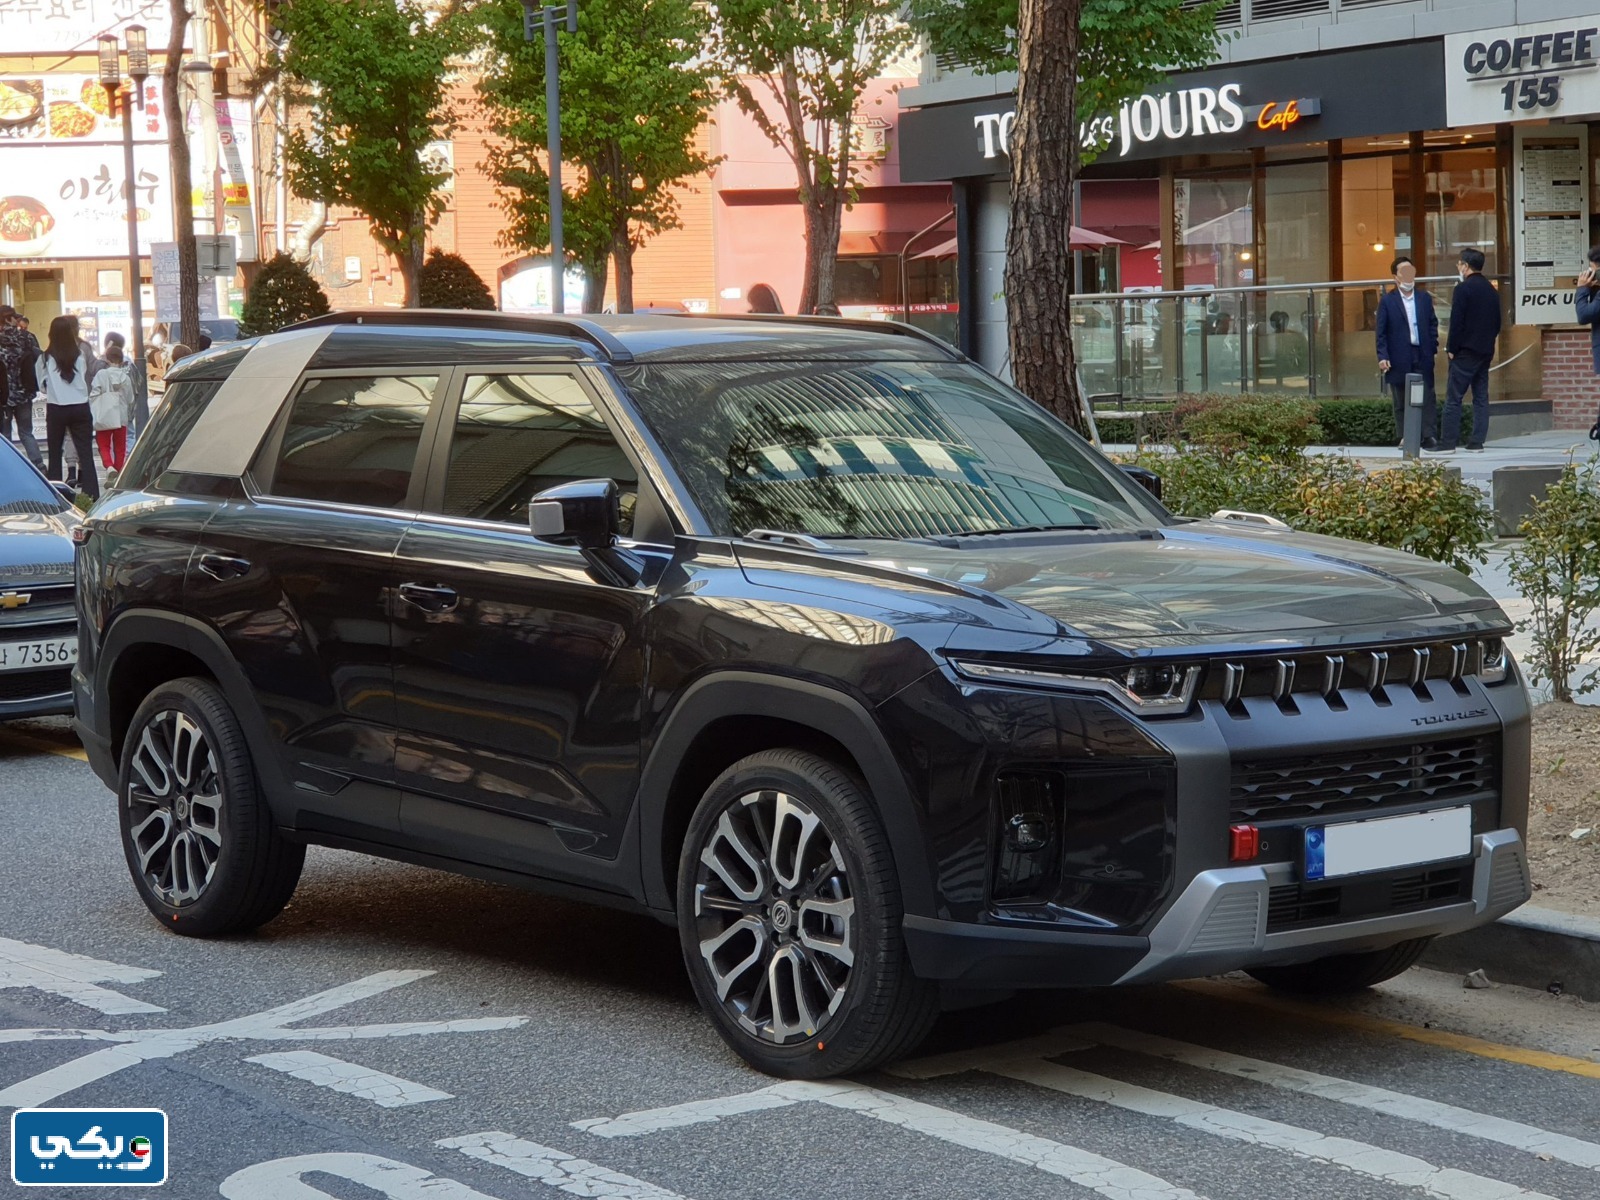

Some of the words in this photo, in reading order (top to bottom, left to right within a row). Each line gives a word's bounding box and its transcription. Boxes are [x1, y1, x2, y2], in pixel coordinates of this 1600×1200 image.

[1463, 27, 1598, 74] COFFEE
[1500, 76, 1559, 111] 155
[1119, 83, 1244, 157] JOURS
[1257, 100, 1299, 131] Café
[1521, 293, 1558, 306] PICK
[1563, 292, 1577, 305] U
[18, 642, 69, 665] 7356
